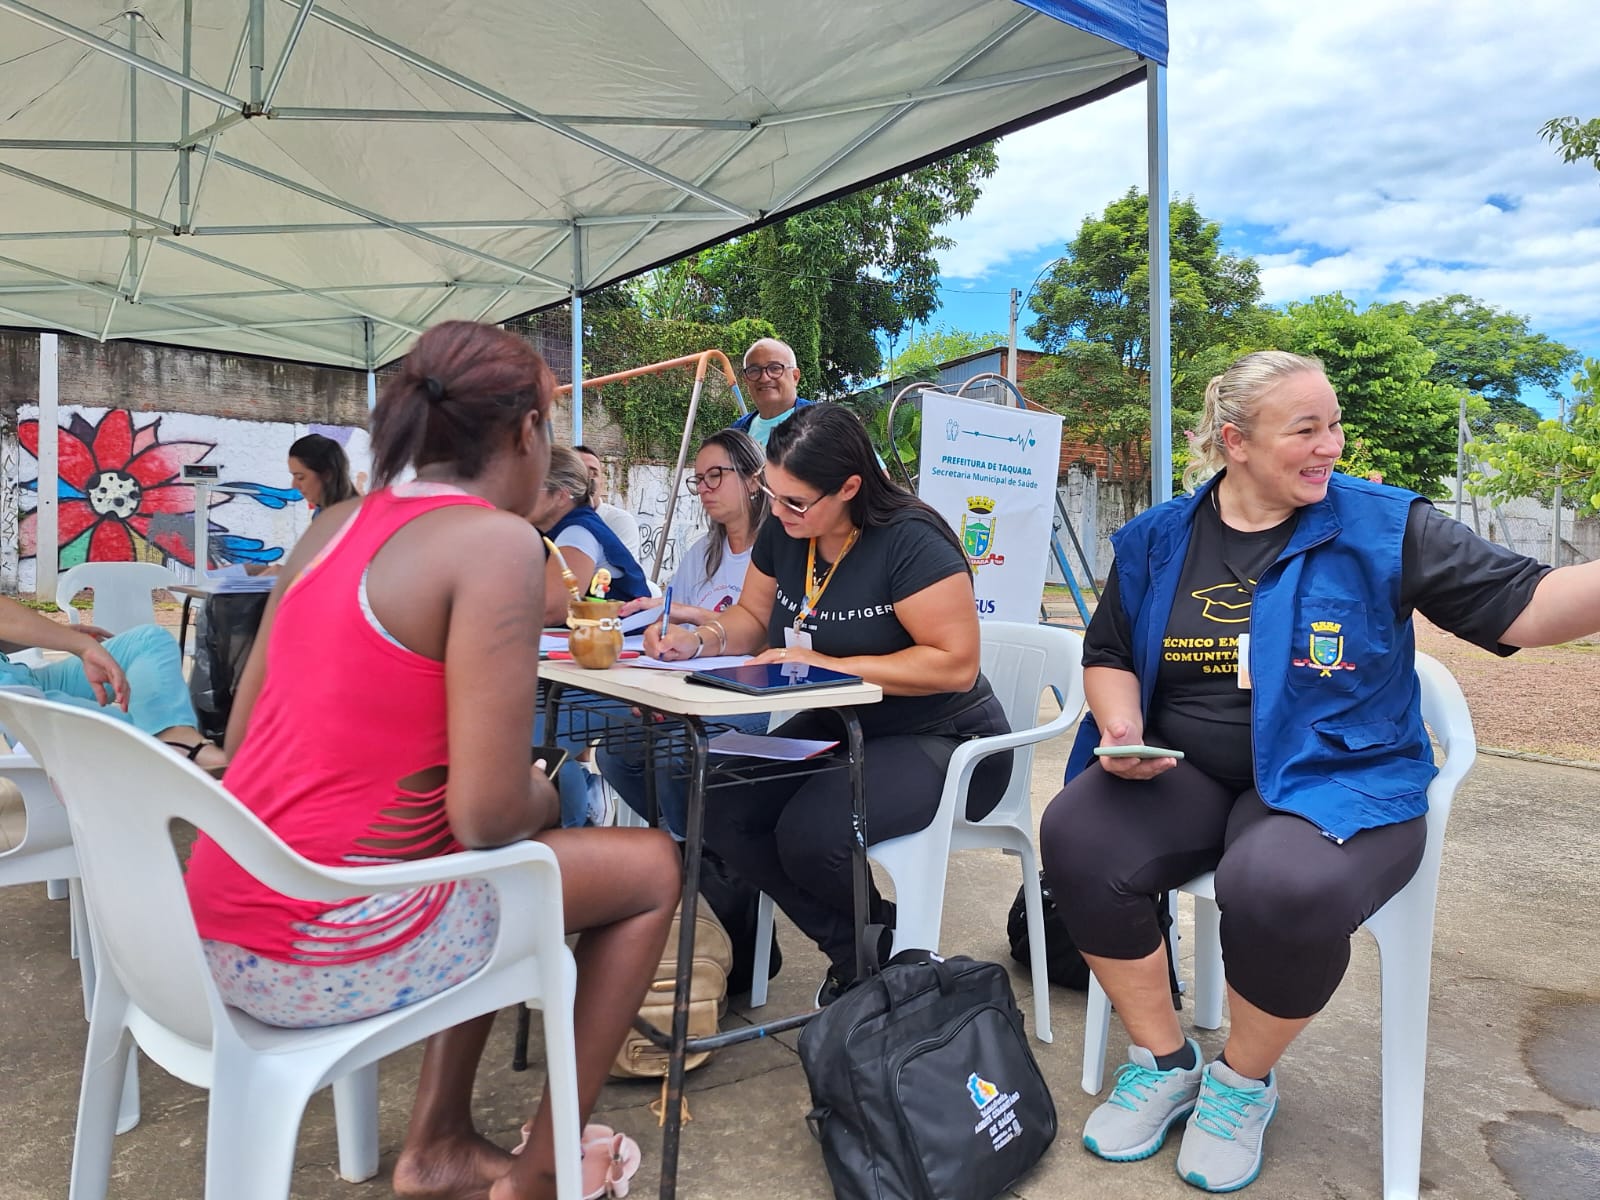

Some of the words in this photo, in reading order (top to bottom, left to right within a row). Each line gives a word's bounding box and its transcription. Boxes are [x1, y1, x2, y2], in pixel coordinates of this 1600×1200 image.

[941, 455, 986, 469] PREFEITURA
[987, 462, 997, 471] DE
[998, 463, 1032, 476] TAQUARA
[931, 466, 971, 480] Secretaria
[972, 472, 1007, 485] Municipal
[1007, 478, 1017, 486] de
[1017, 479, 1038, 489] Saúde
[776, 583, 798, 612] OMM
[820, 604, 894, 621] HILFIGER
[1163, 636, 1214, 648] ÉCNICO
[1218, 637, 1239, 647] EM
[1164, 648, 1238, 662] COMUNITÁ
